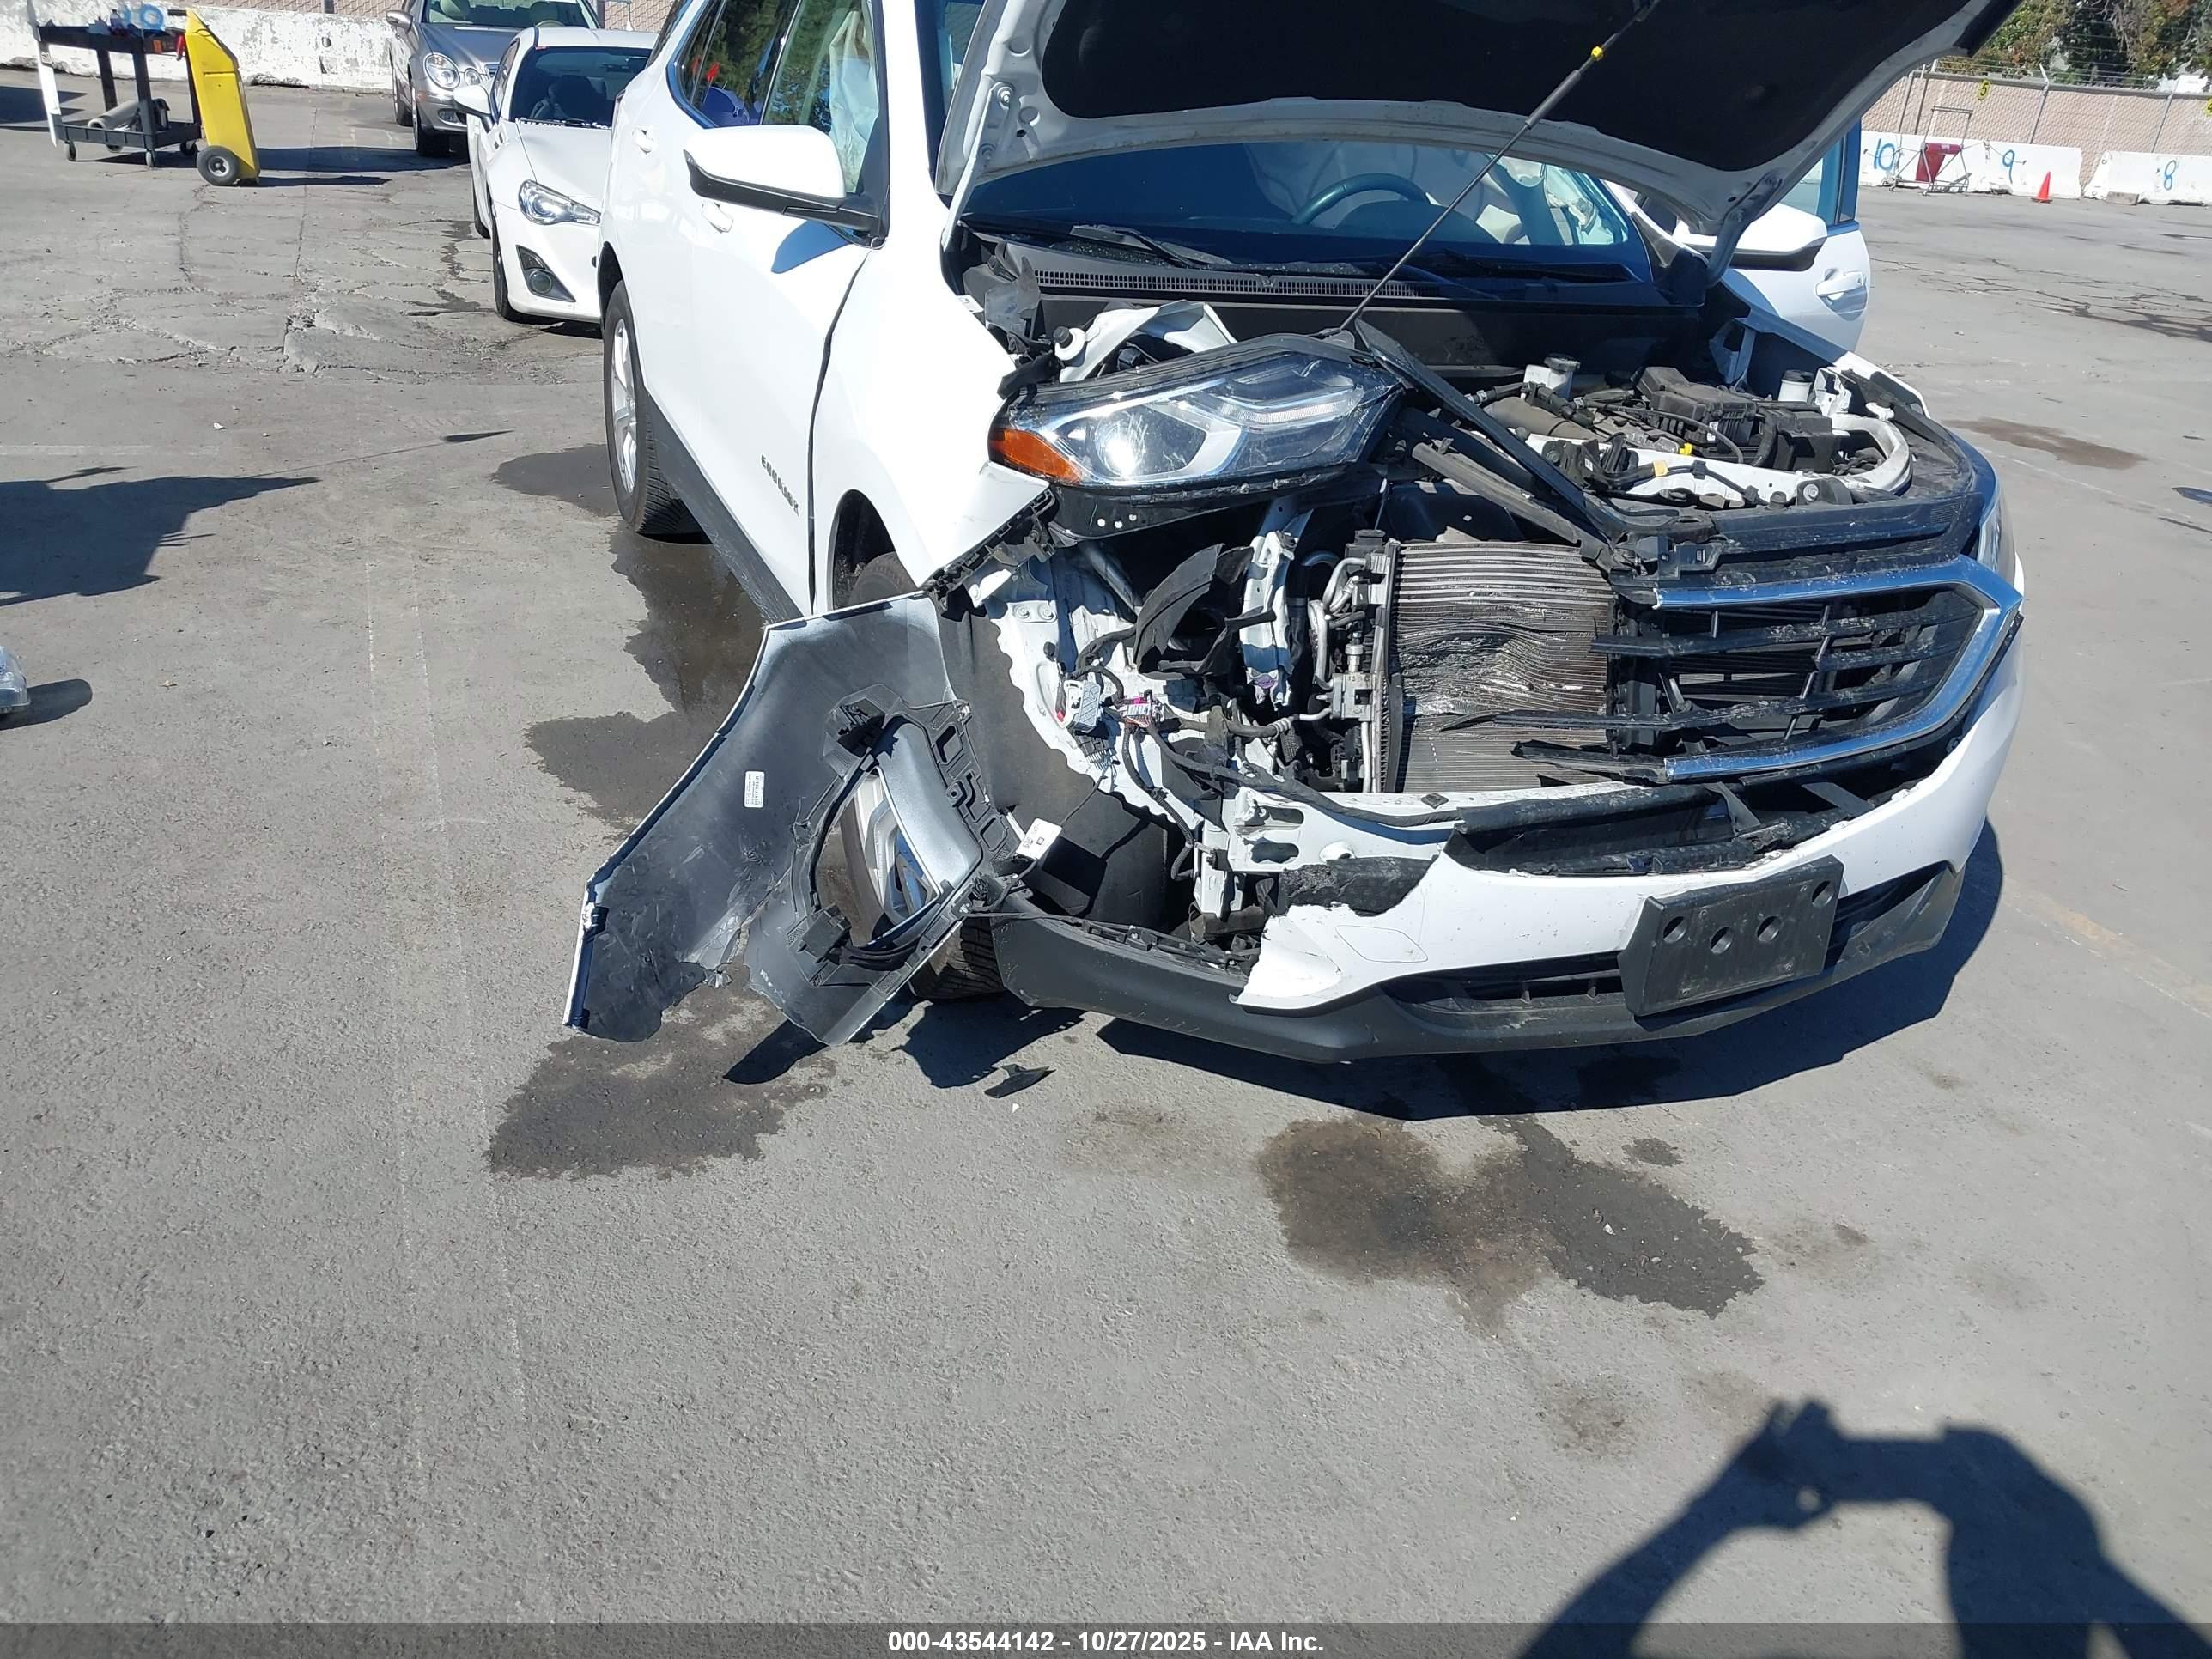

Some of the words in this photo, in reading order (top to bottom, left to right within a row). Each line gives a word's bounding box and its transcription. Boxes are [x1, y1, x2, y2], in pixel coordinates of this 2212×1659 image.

[1980, 82, 1990, 96] 5
[1874, 138, 1895, 171] 10
[2002, 149, 2015, 185] 9
[2163, 160, 2177, 191] 8
